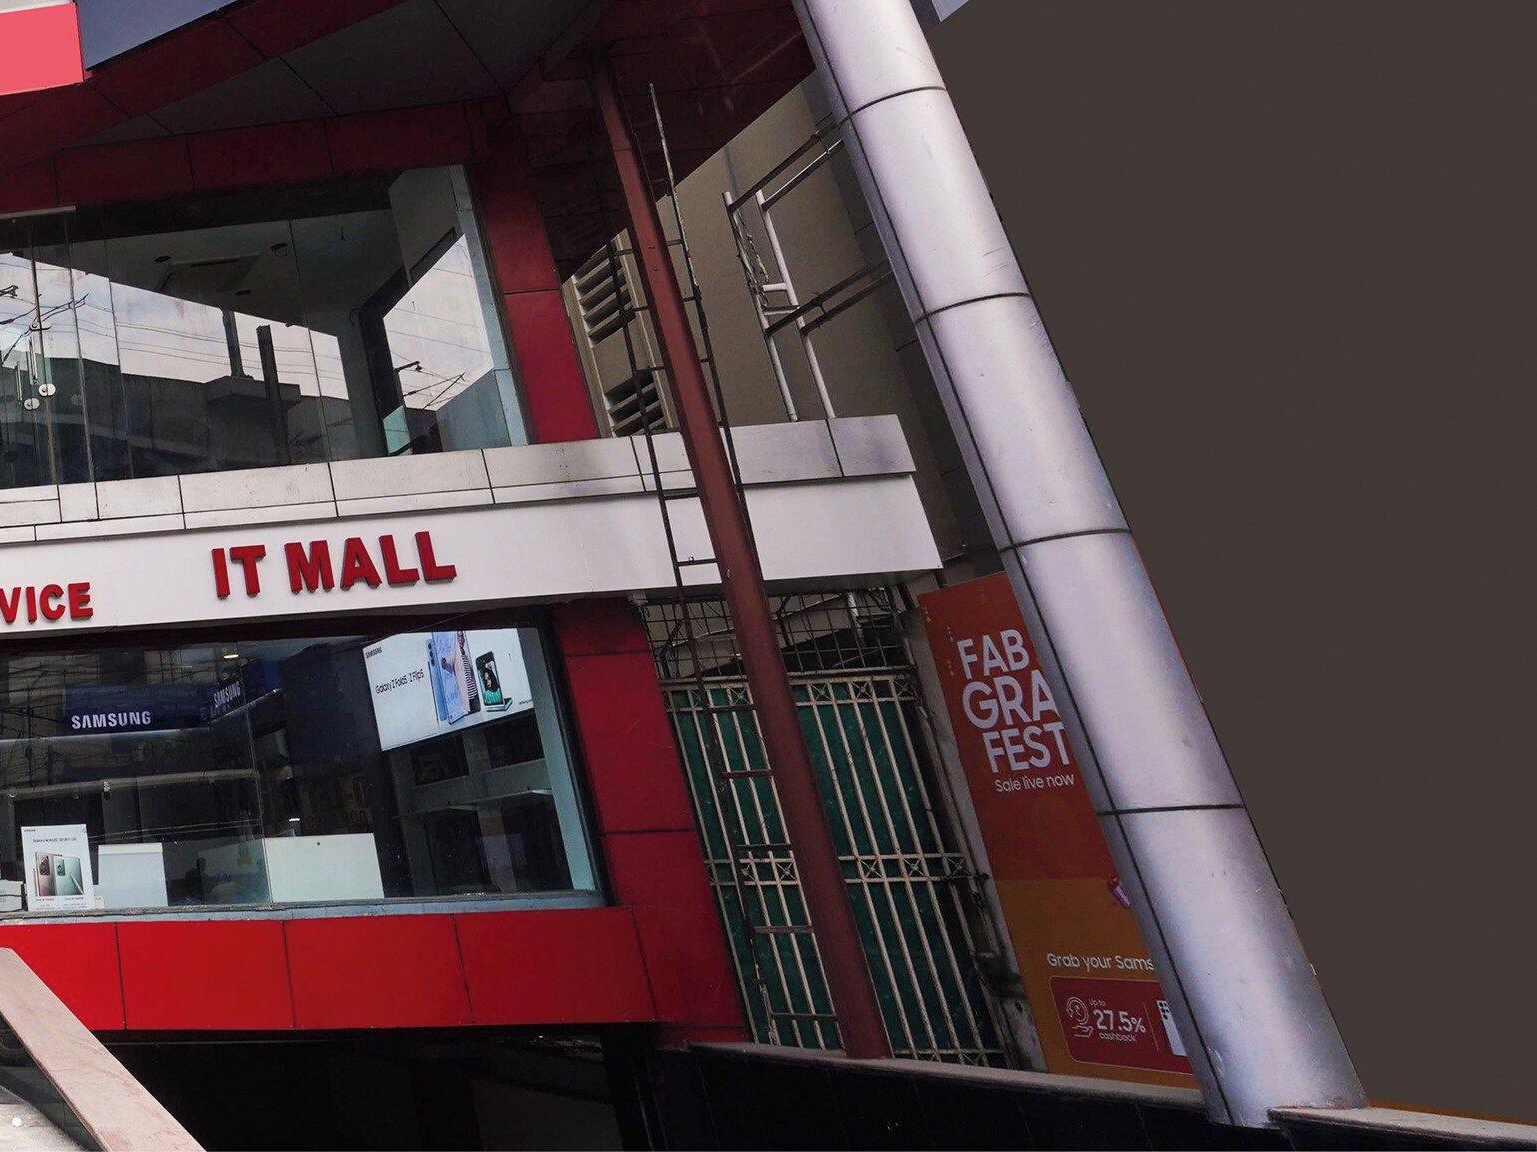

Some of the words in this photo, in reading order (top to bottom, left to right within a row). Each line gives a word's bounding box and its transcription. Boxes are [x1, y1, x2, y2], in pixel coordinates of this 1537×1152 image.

[211, 545, 266, 599] IT
[284, 531, 457, 594] MALL
[957, 629, 1030, 679] FAB
[71, 710, 152, 730] SAMSUNG
[982, 722, 1071, 773] FEST
[995, 777, 1021, 792] Sale
[1022, 774, 1044, 789] live
[1047, 773, 1076, 788] now
[1047, 953, 1080, 967] Grab
[1082, 956, 1111, 973] your
[1093, 1009, 1147, 1033] 27.5%
[1099, 1032, 1137, 1042] cashback
